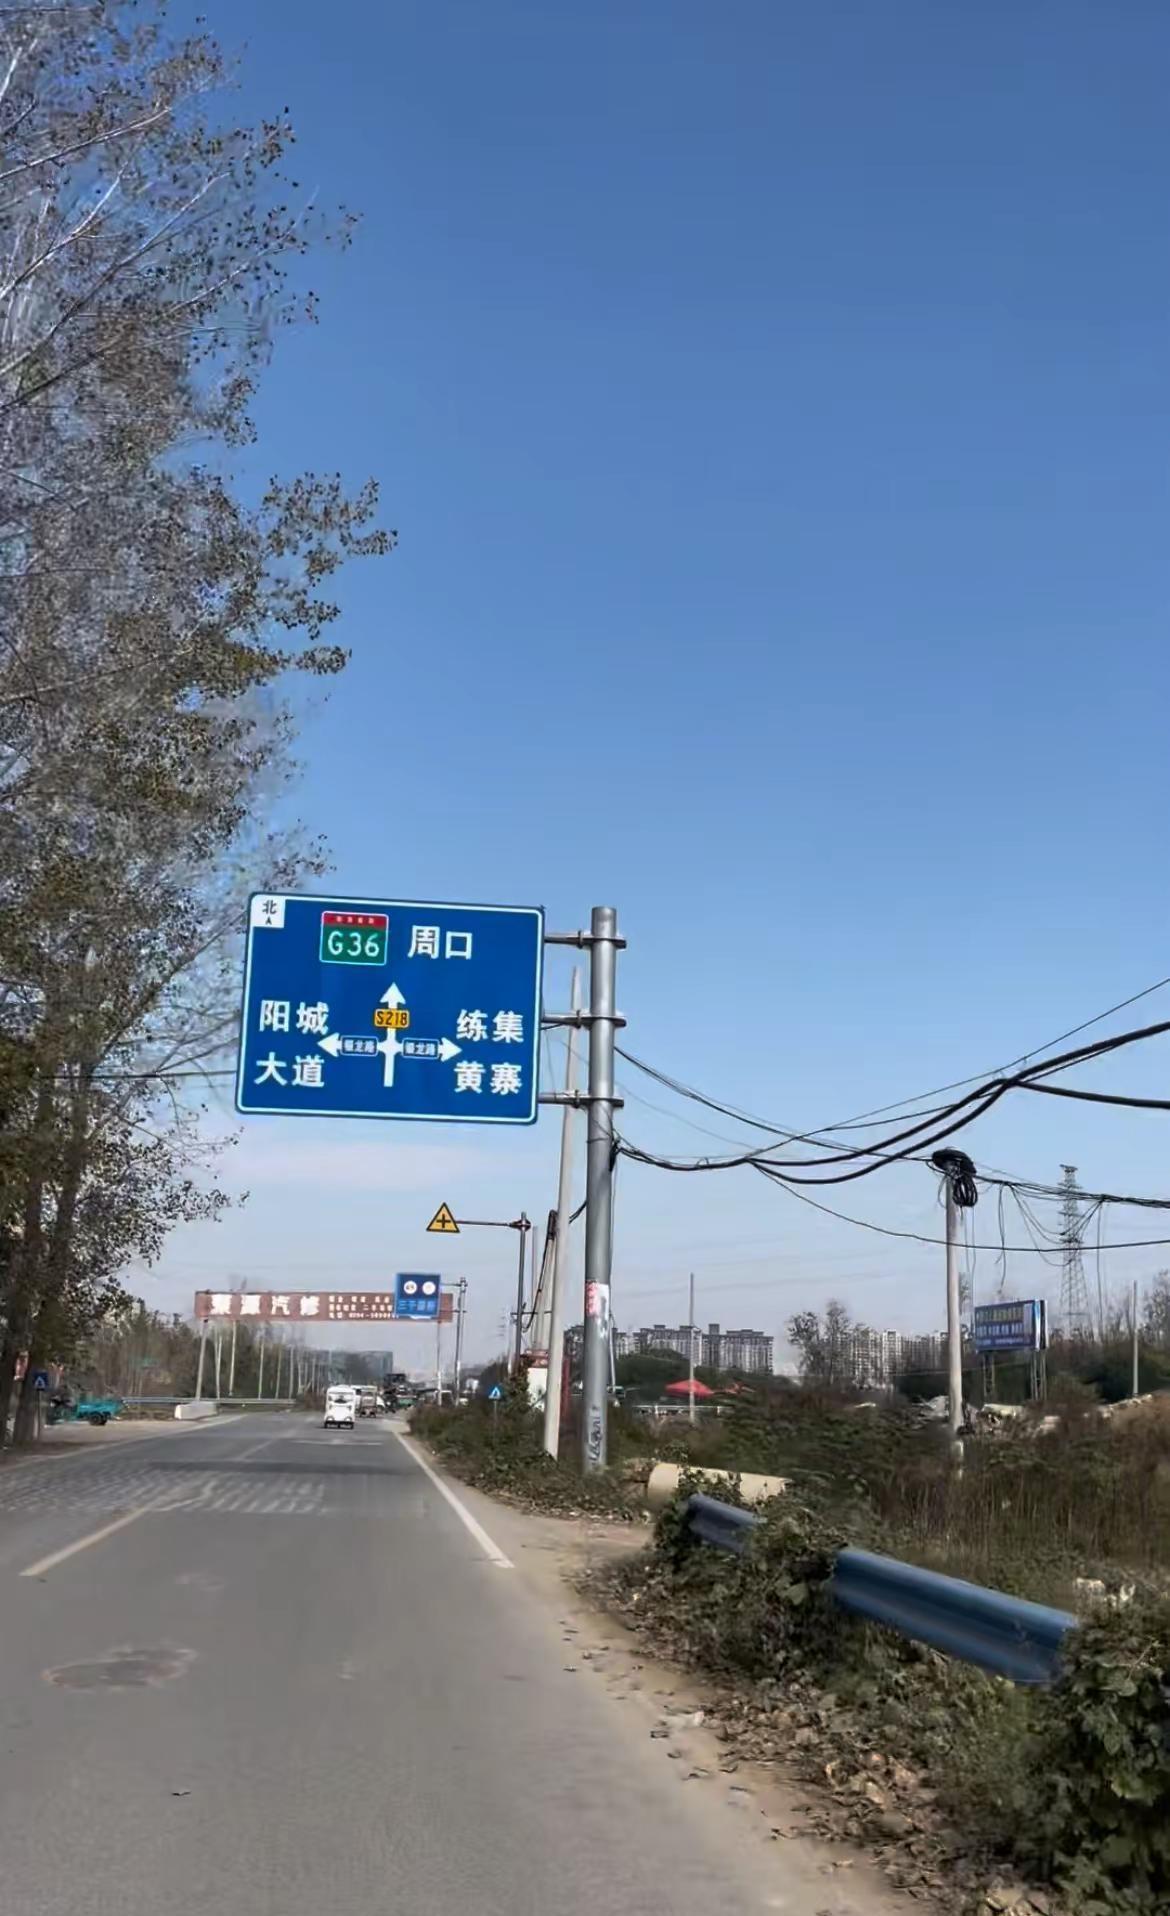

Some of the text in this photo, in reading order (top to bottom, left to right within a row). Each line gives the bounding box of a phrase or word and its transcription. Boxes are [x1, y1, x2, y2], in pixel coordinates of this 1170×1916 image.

[262, 899, 277, 915] 北
[327, 930, 380, 957] G36
[407, 924, 473, 960] 周口
[258, 999, 330, 1035] 阳城
[376, 1010, 408, 1027] S218
[456, 1009, 524, 1043] 练集
[253, 1051, 326, 1088] 大道
[453, 1060, 523, 1095] 黄寨
